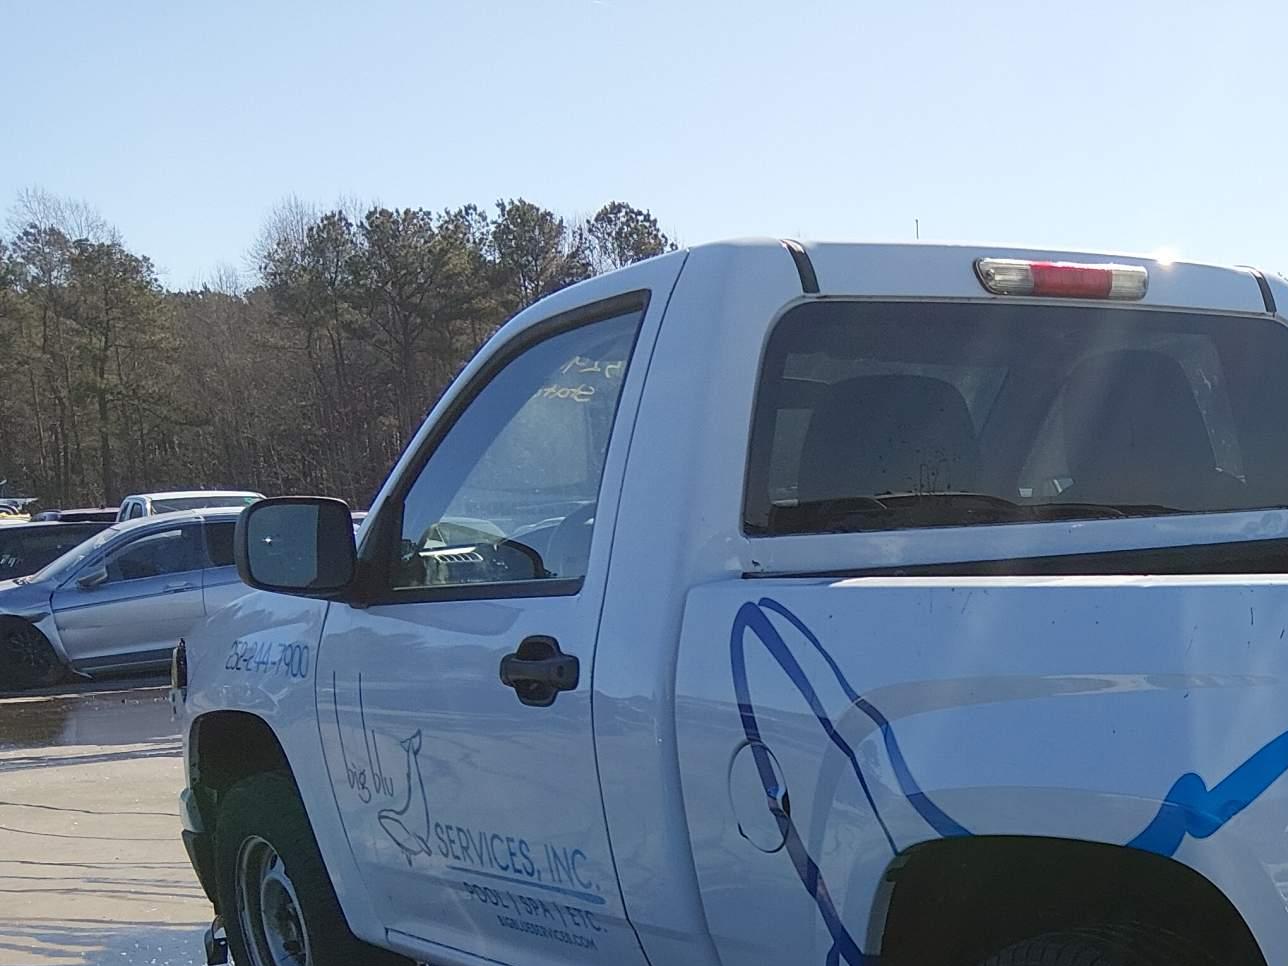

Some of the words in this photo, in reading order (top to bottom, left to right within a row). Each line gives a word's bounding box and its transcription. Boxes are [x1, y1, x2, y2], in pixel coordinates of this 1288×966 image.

[225, 640, 309, 678] 252-244-7900
[434, 821, 542, 881] SERVICES,
[544, 843, 601, 891] INC.
[463, 881, 510, 909] POOL
